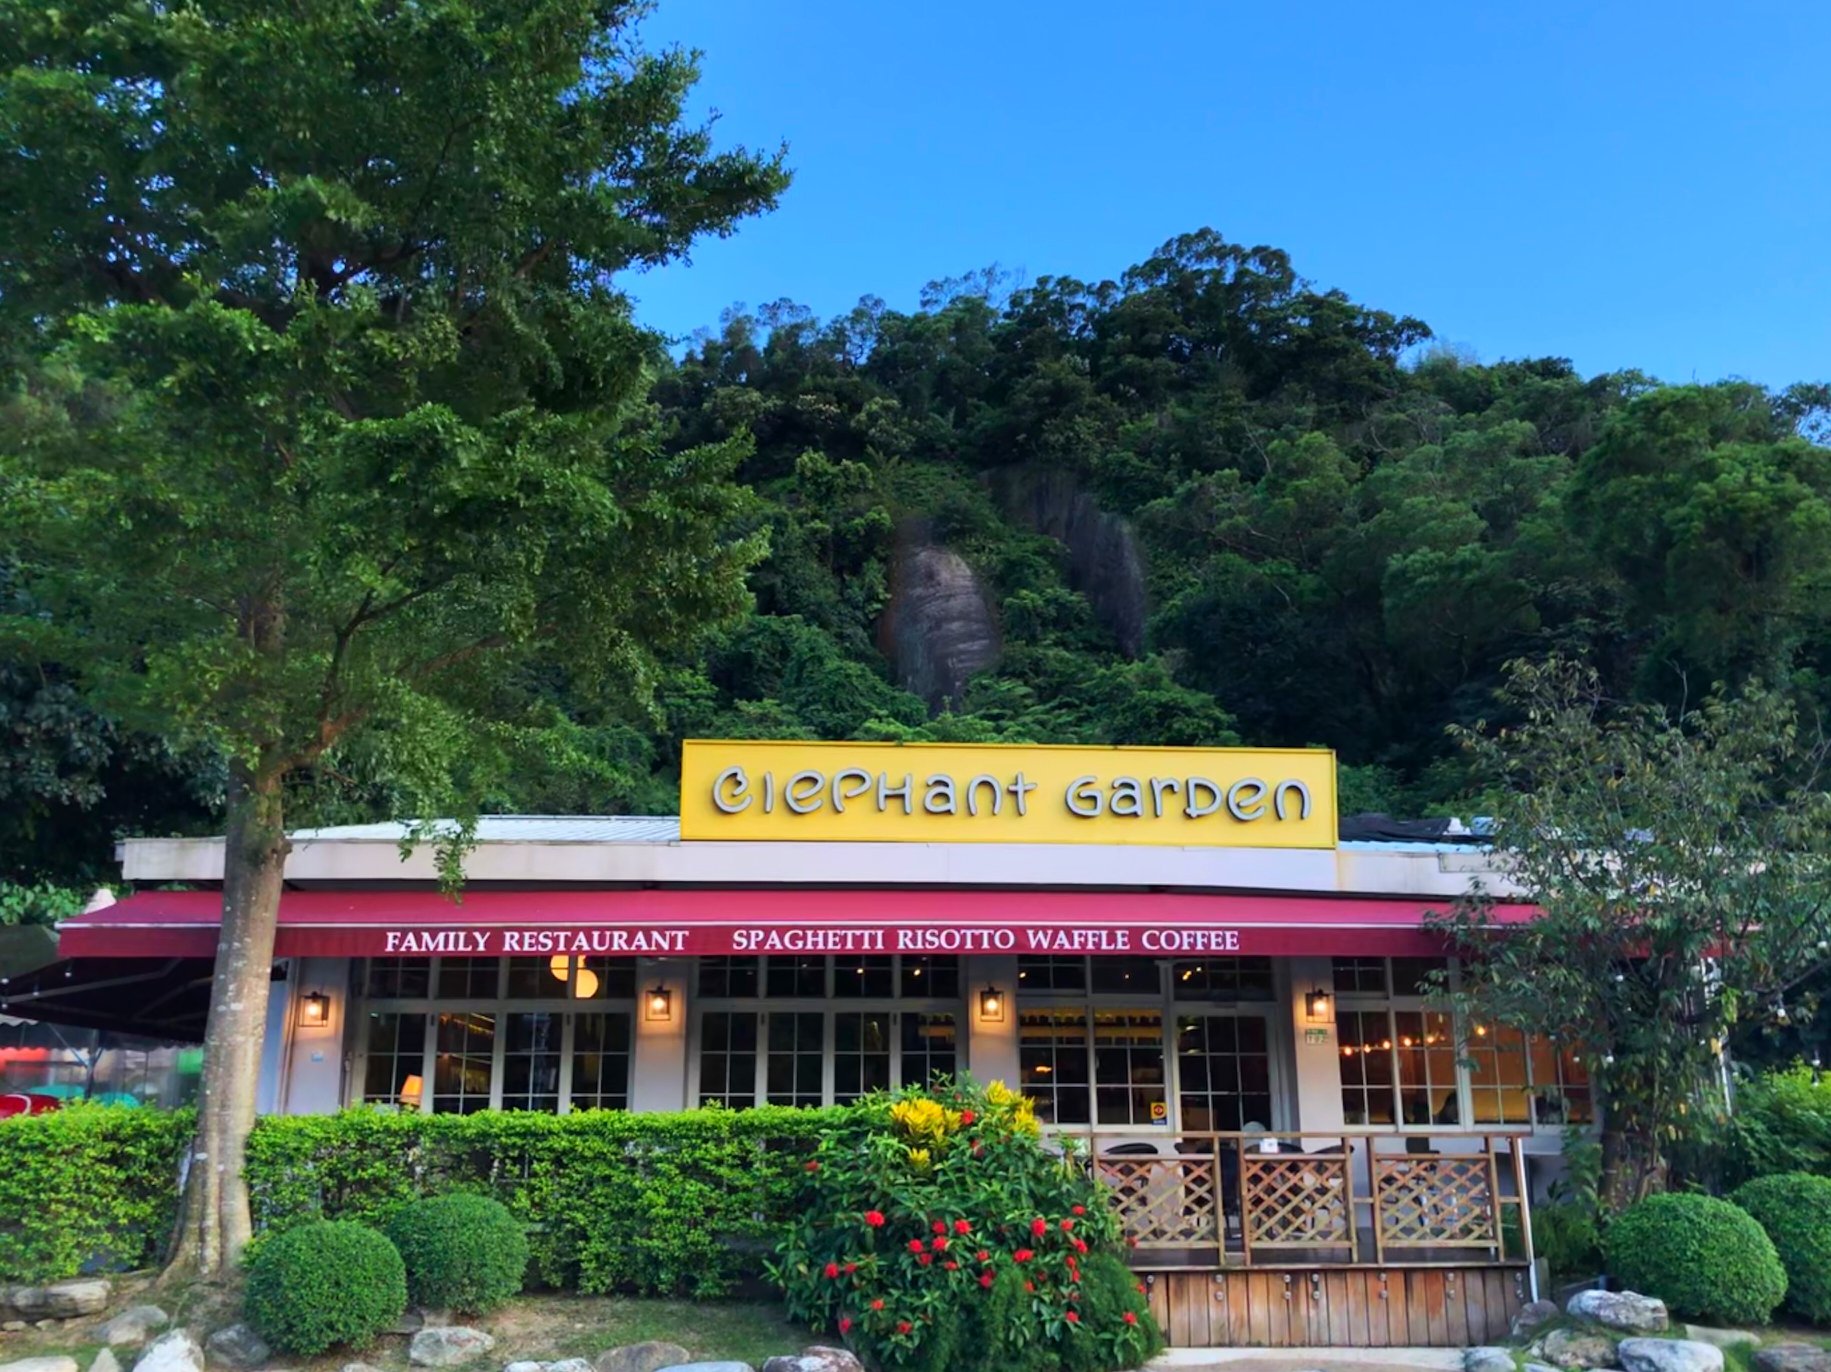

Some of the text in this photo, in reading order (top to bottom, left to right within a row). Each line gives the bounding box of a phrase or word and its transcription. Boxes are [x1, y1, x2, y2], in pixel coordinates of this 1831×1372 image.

[384, 929, 1240, 953] FAMILY RESTAURANT SPAGHETTI RISOTTO WAFFLE COFFEE
